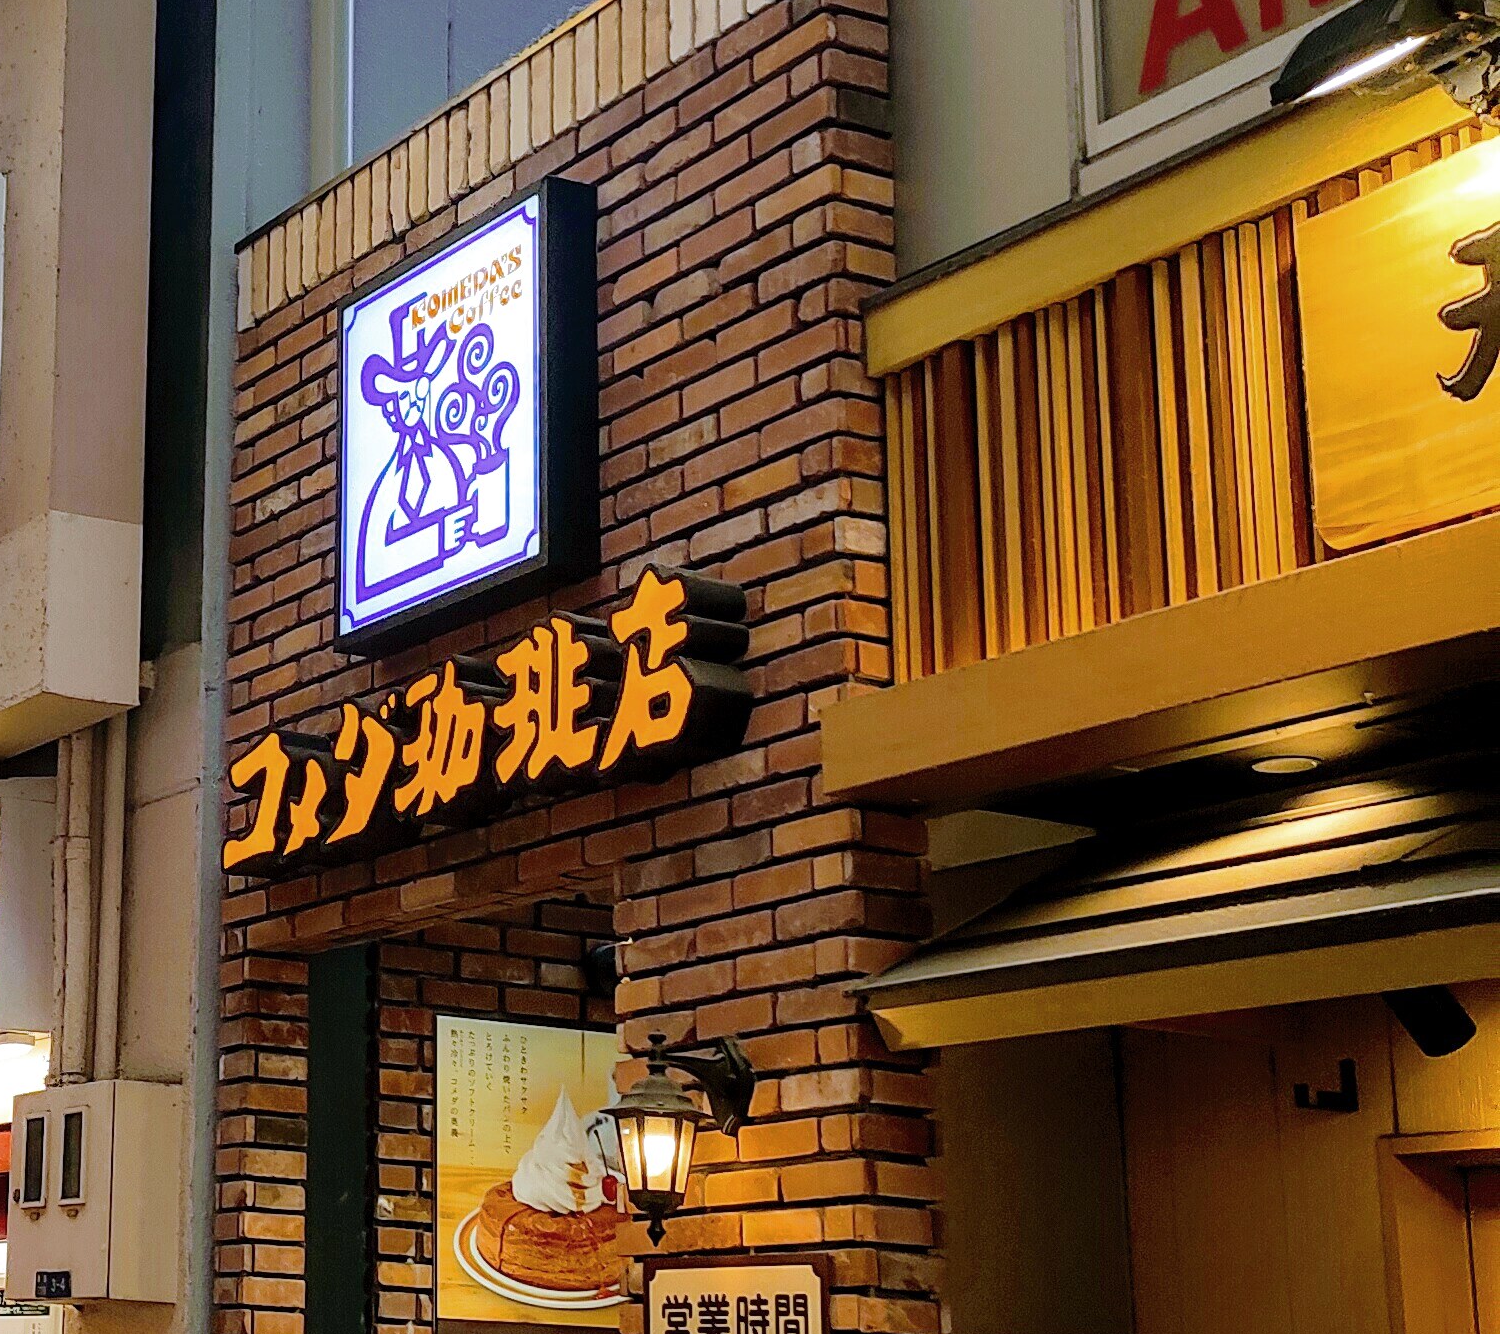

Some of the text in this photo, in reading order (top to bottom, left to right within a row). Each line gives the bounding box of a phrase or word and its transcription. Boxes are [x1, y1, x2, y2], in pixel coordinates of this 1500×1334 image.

[223, 568, 693, 870] コメダ珈琲店
